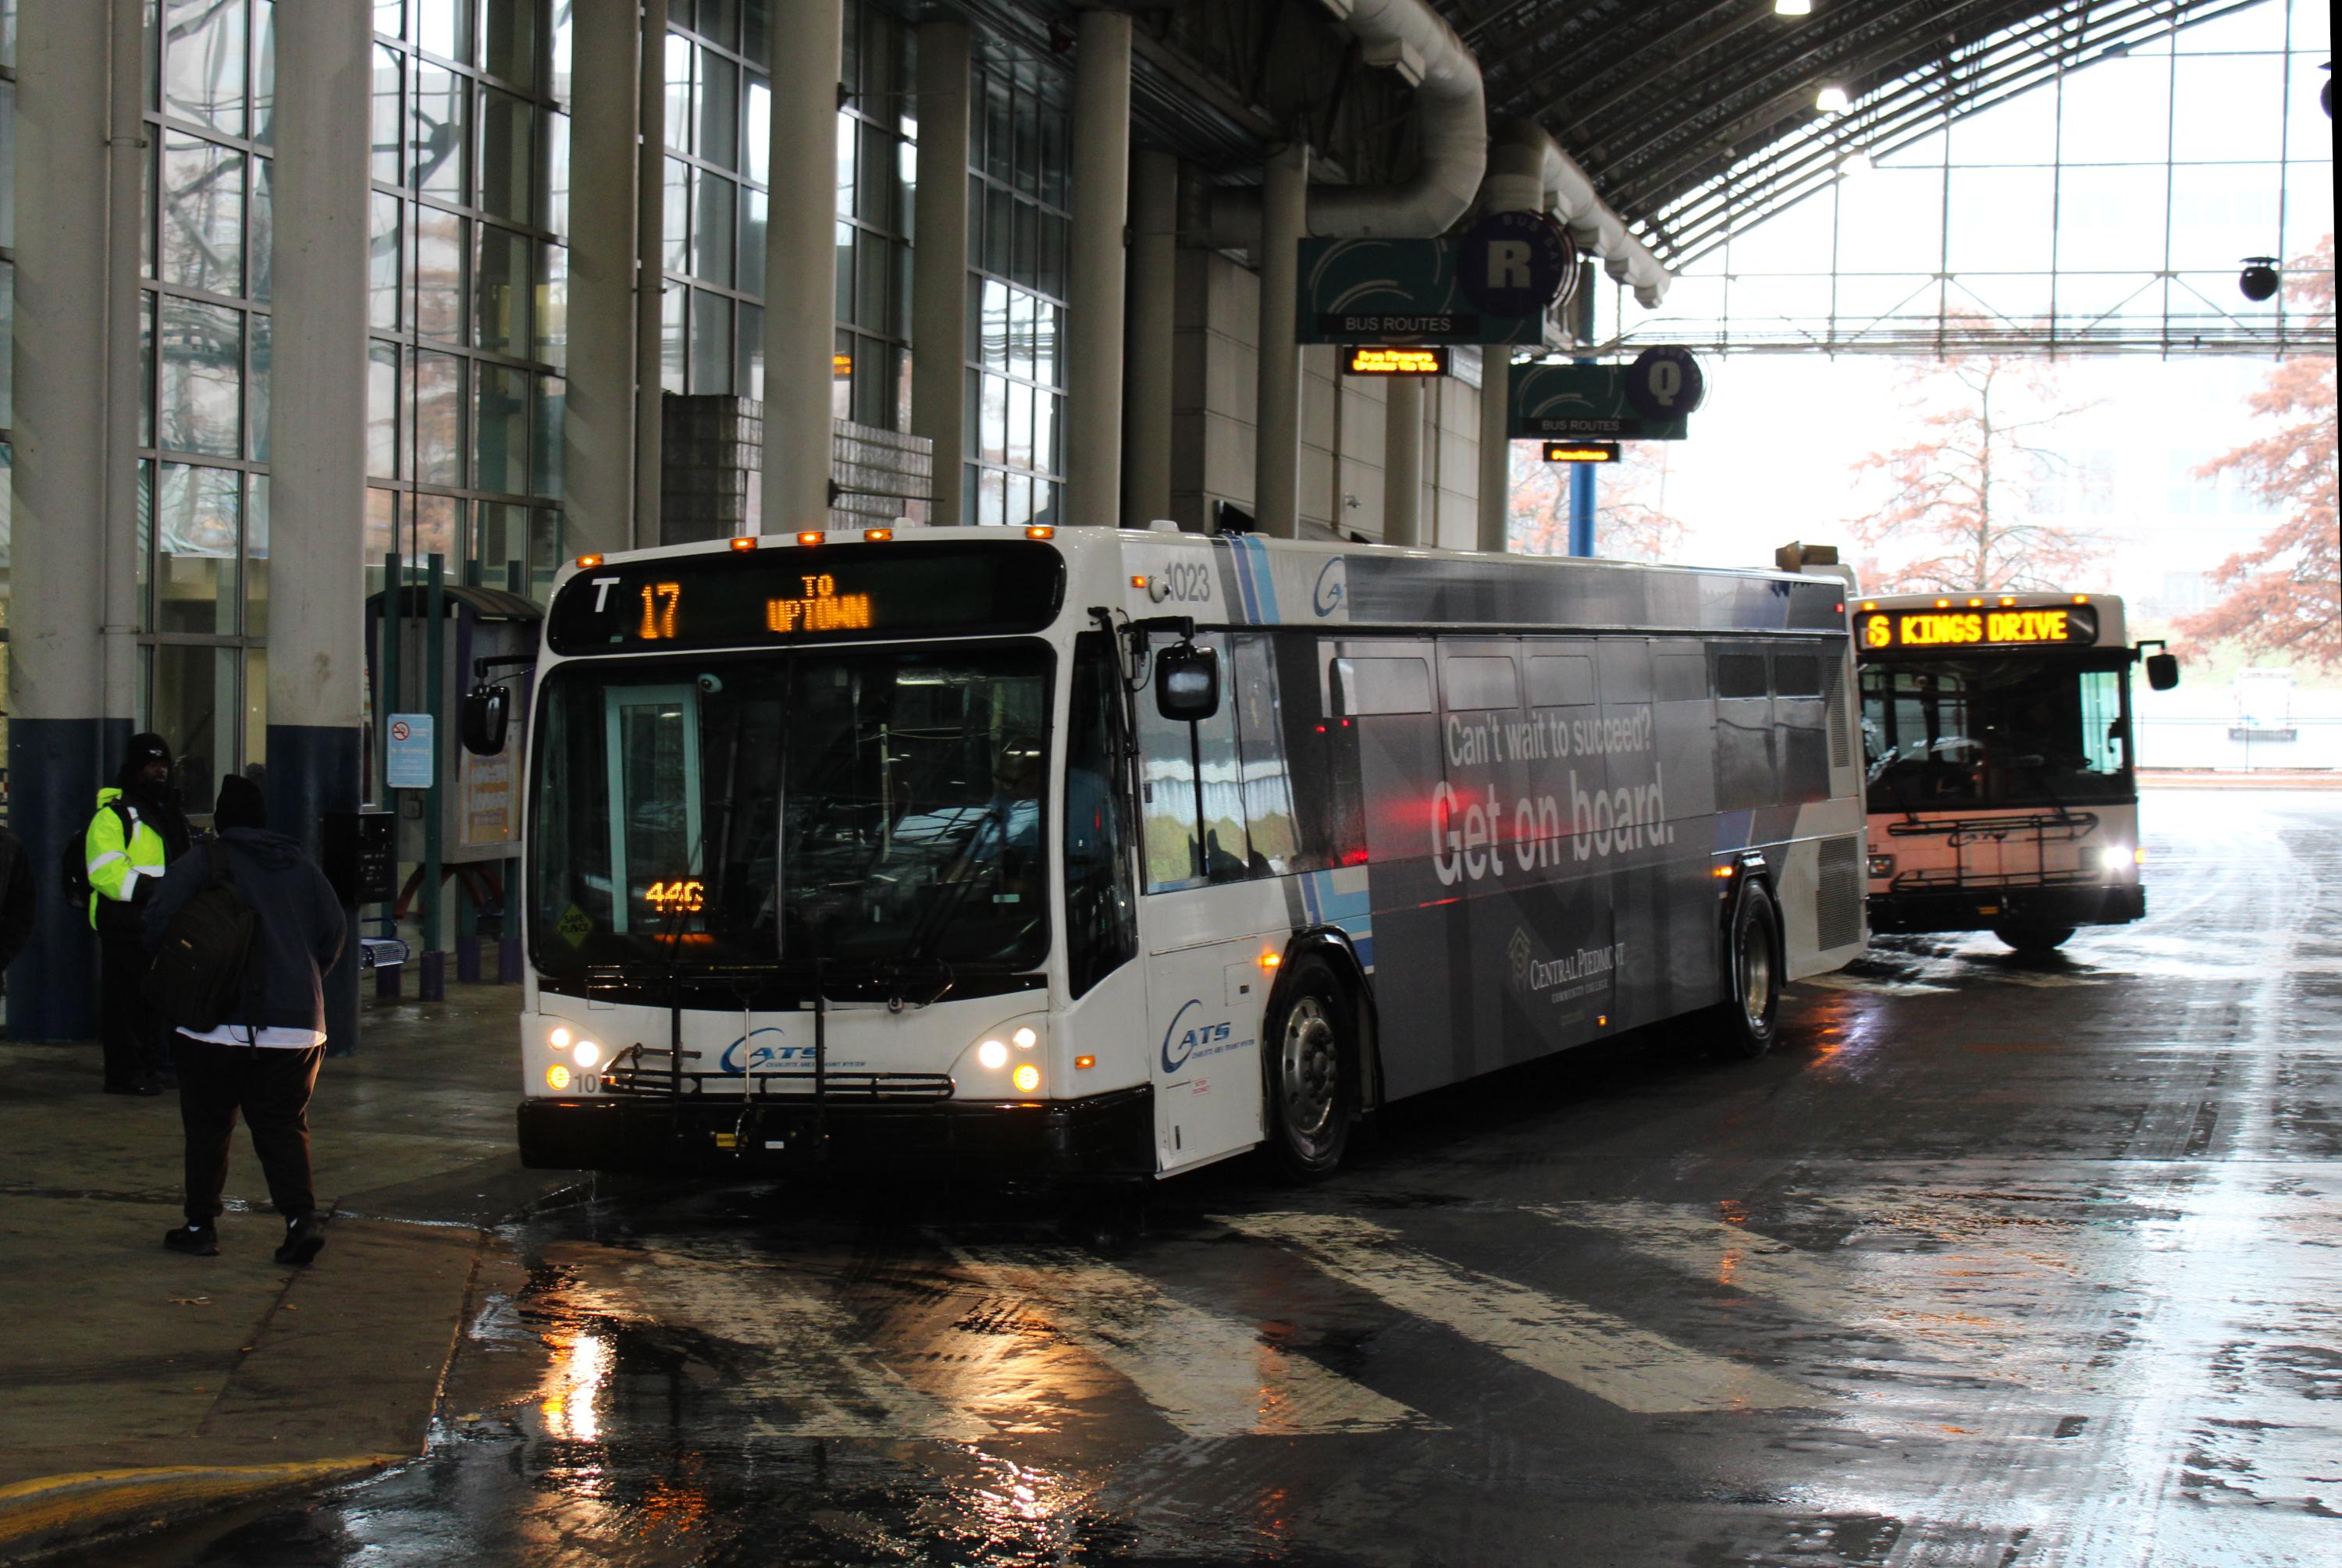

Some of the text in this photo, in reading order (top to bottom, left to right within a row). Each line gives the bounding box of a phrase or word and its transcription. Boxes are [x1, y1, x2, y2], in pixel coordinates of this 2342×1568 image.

[1487, 240, 1532, 288] R
[1345, 316, 1451, 332] BUS ROUTES
[1648, 360, 1682, 407] Q
[1542, 420, 1620, 432] BUS ROUTES
[591, 577, 621, 613] T
[801, 574, 835, 598] TO
[1165, 562, 1211, 602] 1023
[639, 581, 681, 640] 17
[767, 593, 870, 633] UPTOWN
[1901, 614, 1981, 645] KINGS
[1988, 611, 2069, 642] DRIVE
[1447, 705, 1652, 767] Can't wait to succeed?
[1430, 761, 1675, 887] Get on board.
[1161, 998, 1231, 1074] CATS
[574, 1073, 597, 1093] 10
